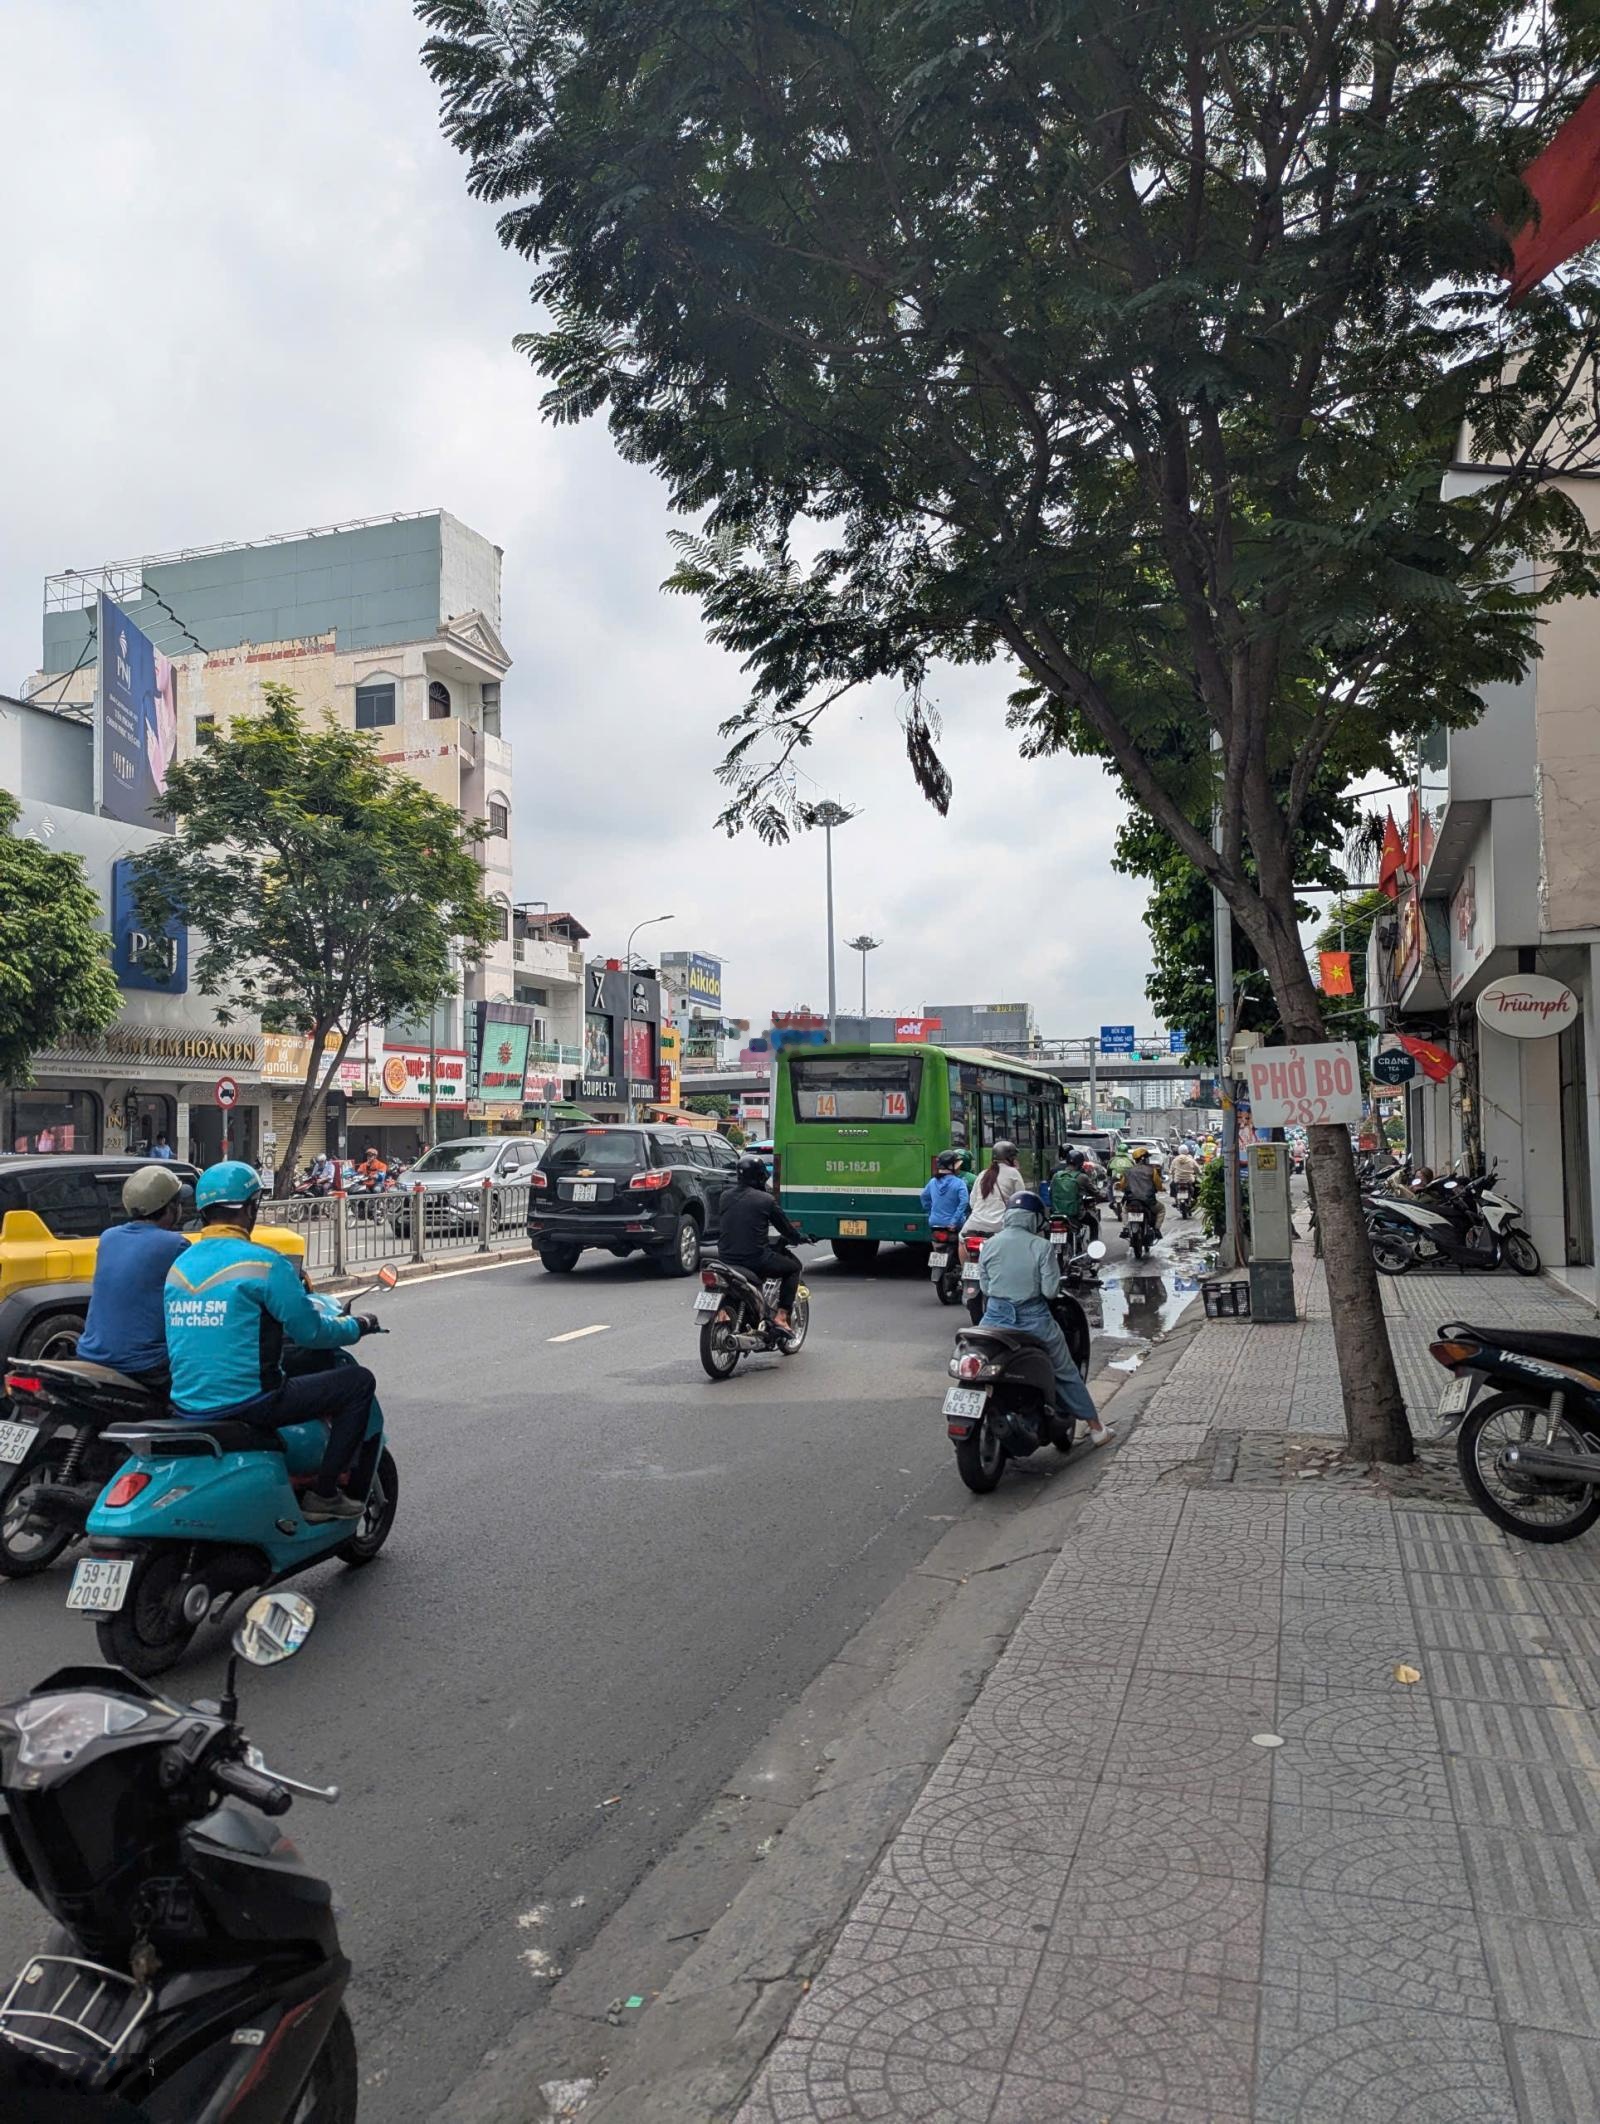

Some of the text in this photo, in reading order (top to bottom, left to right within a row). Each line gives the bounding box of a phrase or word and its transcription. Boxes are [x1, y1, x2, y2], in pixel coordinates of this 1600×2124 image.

[117, 655, 131, 690] PNJ
[690, 967, 720, 997] Aikido
[1483, 990, 1570, 1020] Triumph
[149, 1036, 179, 1057] KIM
[183, 1036, 232, 1059] HOÀN
[1378, 1057, 1410, 1065] CRANE
[1251, 1048, 1353, 1101] PHỞ BÒ
[418, 1083, 437, 1095] VEG
[582, 1081, 617, 1097] COUPLE TX
[818, 1096, 834, 1116] 14
[886, 1094, 906, 1115] 14
[1281, 1098, 1331, 1125] 282
[826, 1160, 881, 1173] 51B-162.81
[168, 1300, 228, 1314] XANH SM
[170, 1313, 224, 1327] xin chào!
[82, 1564, 122, 1585] 59-TA
[72, 1586, 121, 1608] 209.91
